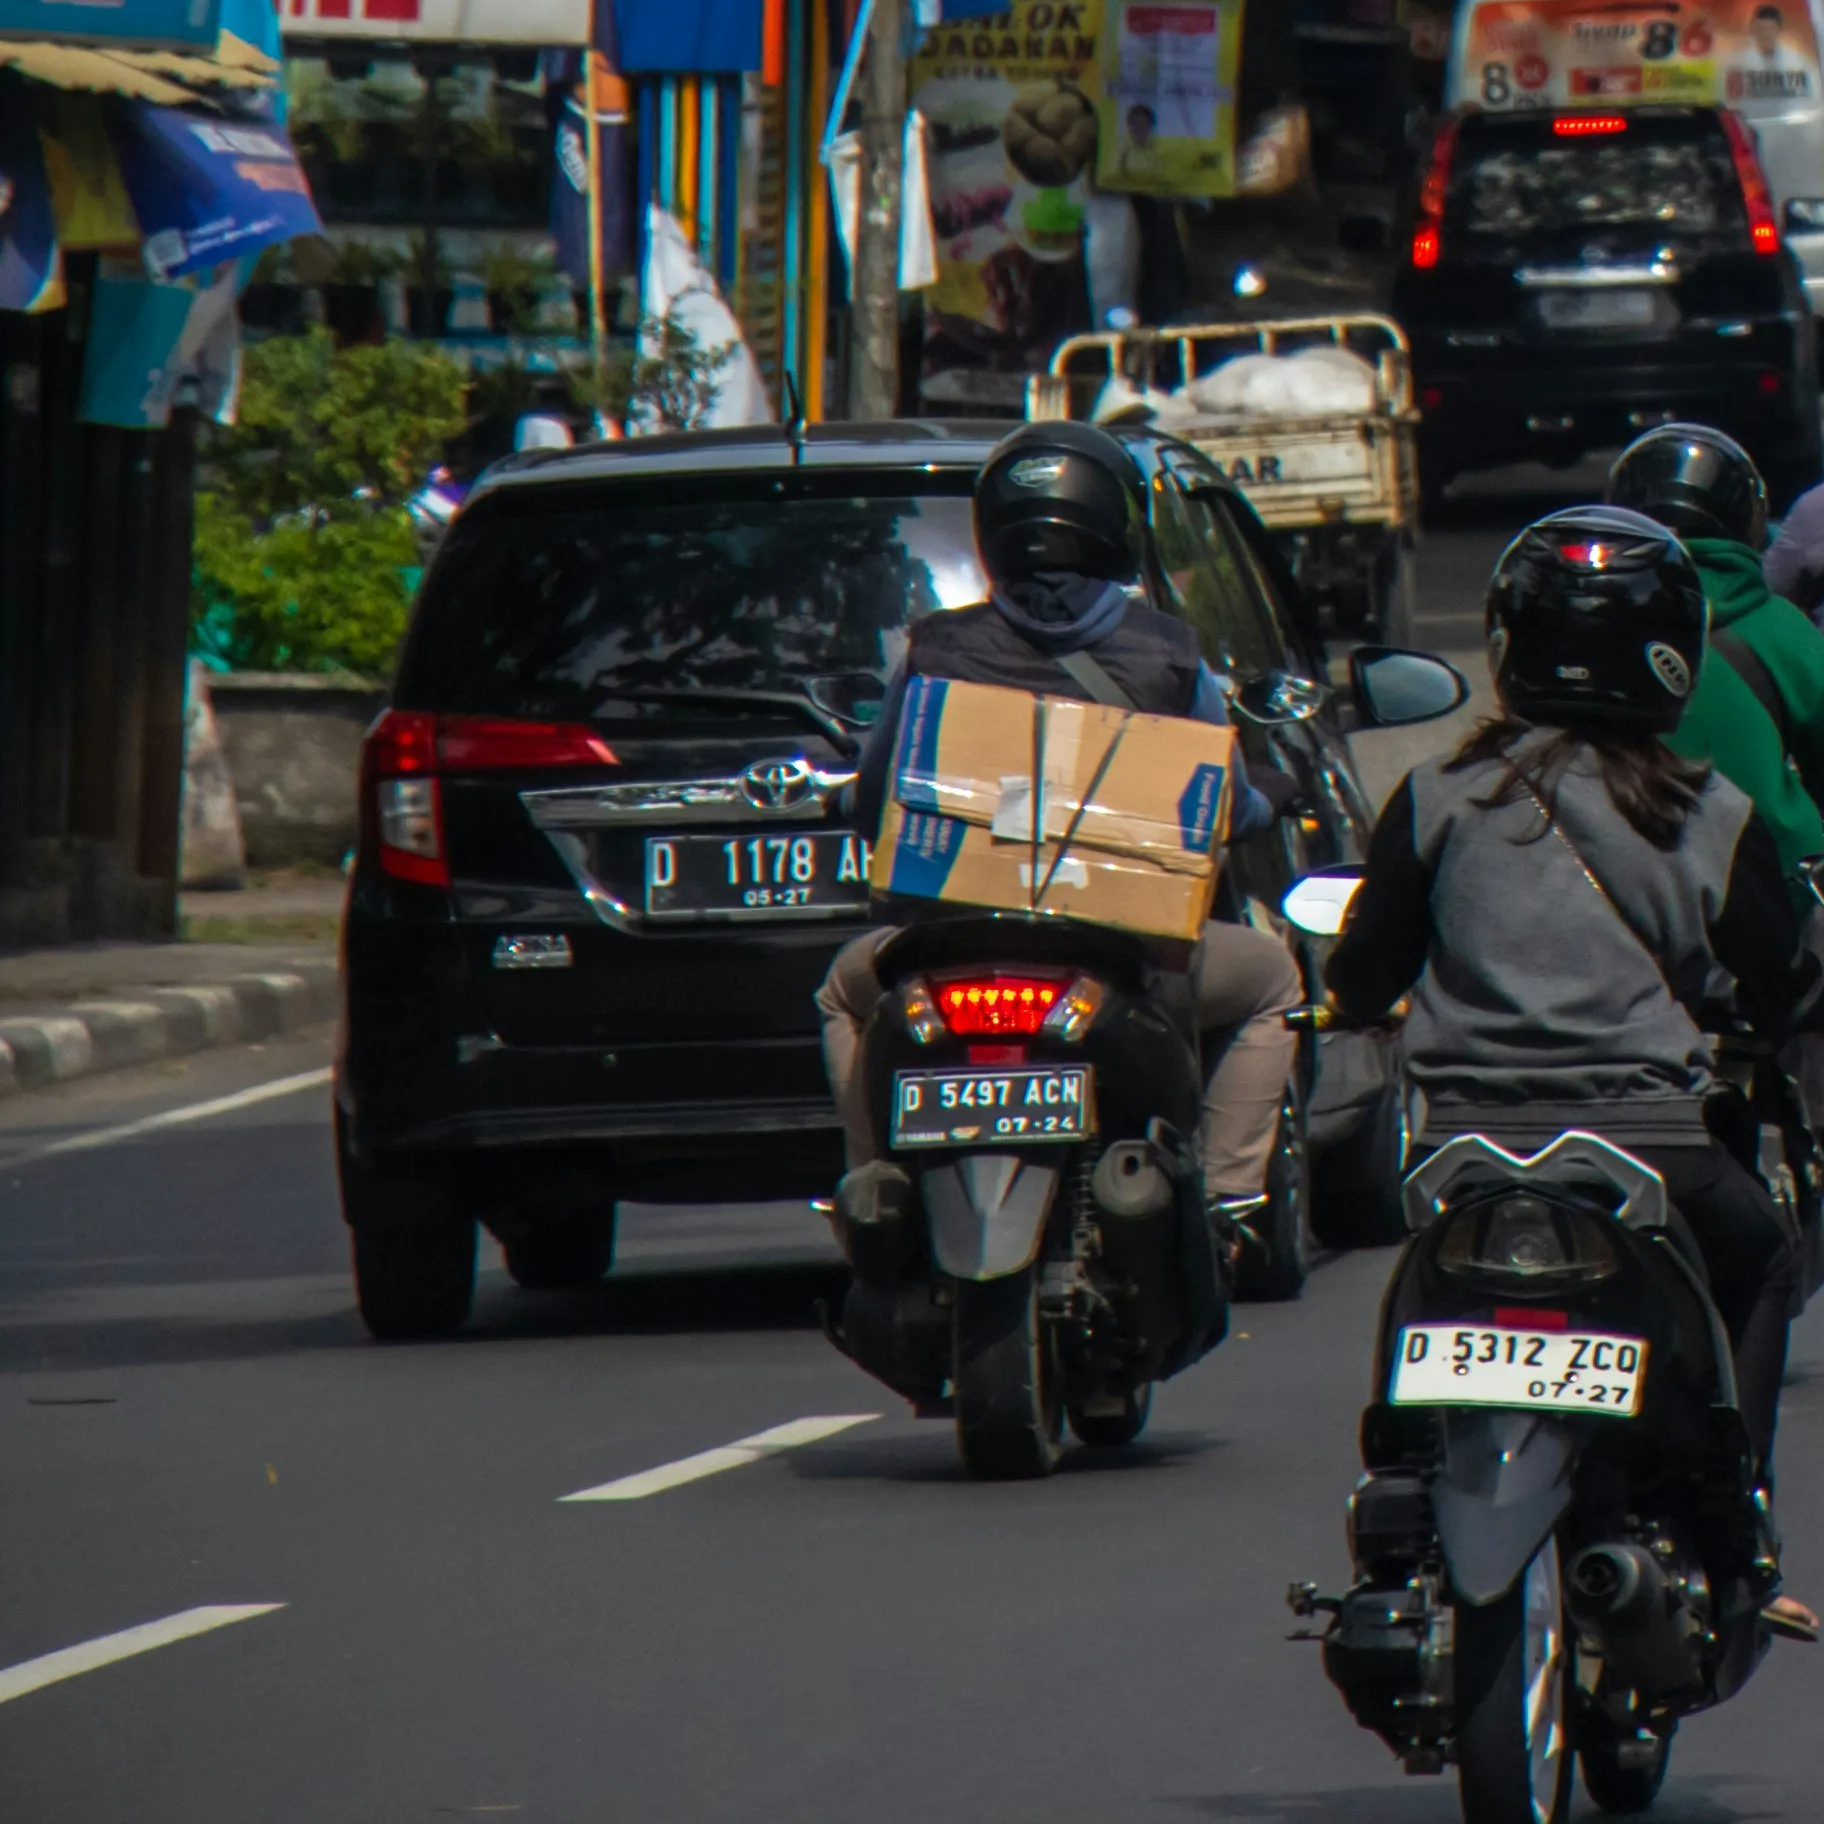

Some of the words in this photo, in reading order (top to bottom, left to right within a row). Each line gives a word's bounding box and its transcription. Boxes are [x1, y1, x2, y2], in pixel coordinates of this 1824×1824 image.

[652, 842, 677, 887] D
[723, 837, 815, 885] 1178
[904, 1083, 922, 1111] D
[941, 1080, 1012, 1108] 5497
[1025, 1077, 1080, 1106] ACN
[1406, 1332, 1430, 1365] D
[1452, 1331, 1547, 1366] 5312
